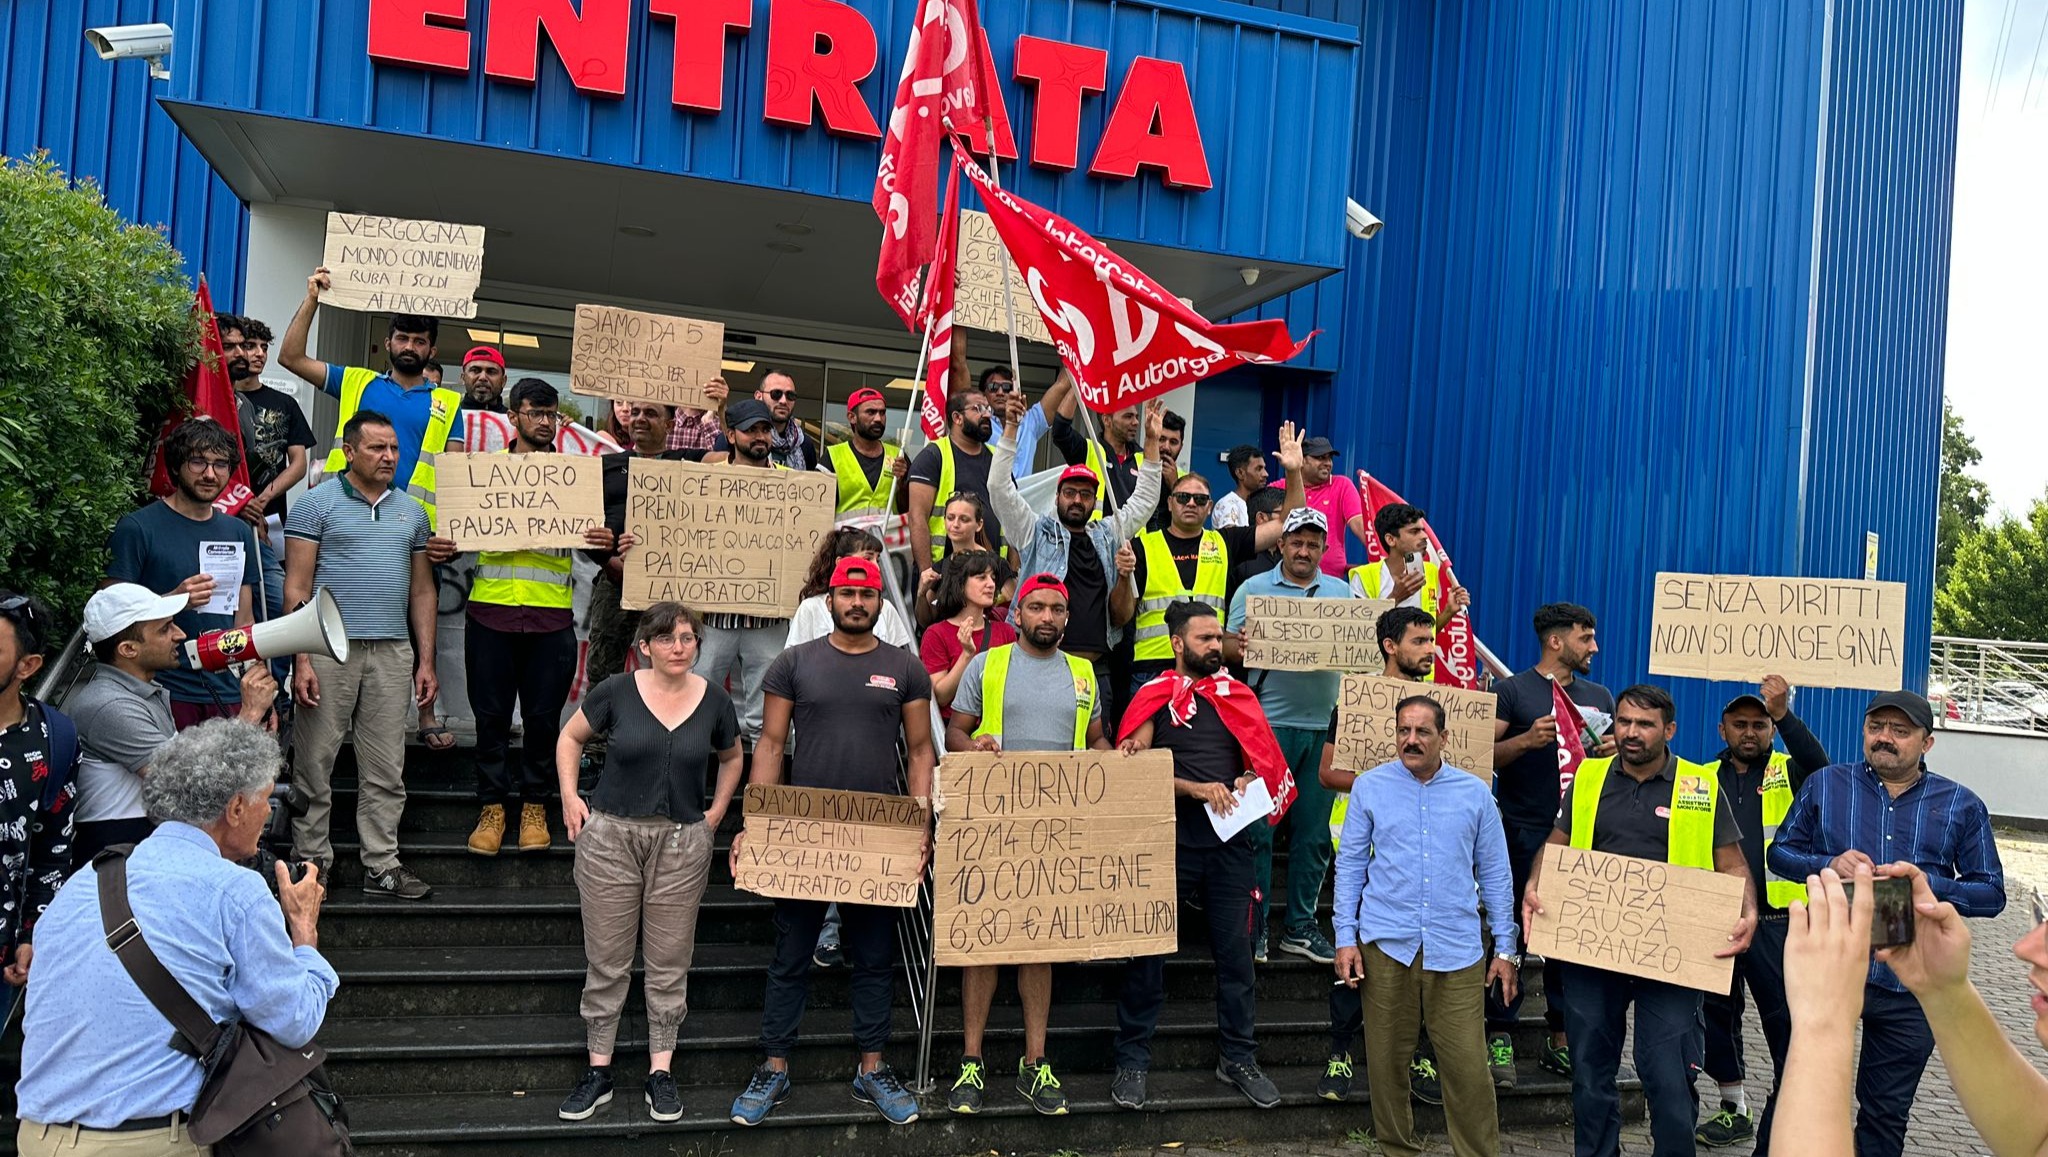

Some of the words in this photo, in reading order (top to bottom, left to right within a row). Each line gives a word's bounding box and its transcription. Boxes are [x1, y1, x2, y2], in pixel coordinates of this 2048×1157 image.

[340, 214, 468, 245] VERGOGNA
[964, 214, 984, 238] 12
[340, 245, 398, 266] MONDO
[402, 249, 480, 272] CONVENIENZA
[966, 242, 980, 260] 6
[350, 270, 390, 285] RUBA
[412, 274, 449, 288] SOLDI
[579, 308, 640, 338] SIAMO
[647, 320, 675, 342] DA
[686, 324, 703, 344] 5
[954, 300, 998, 328] BASTA
[577, 334, 636, 358] GIORNI
[644, 344, 662, 361] IN
[574, 354, 664, 380] SCIOPERO
[668, 366, 686, 384] PER
[696, 370, 699, 386] I
[574, 374, 630, 394] NOSTRI
[644, 381, 701, 404] DIRITTI
[468, 464, 576, 488] LAVORO
[632, 473, 672, 494] NON
[720, 478, 827, 508] PARCHEGGIO?
[479, 491, 560, 510] SENZA
[632, 495, 695, 521] PRENDI
[704, 504, 727, 524] LA
[450, 516, 518, 540] PAUSA
[528, 516, 596, 537] PRANZO
[632, 524, 649, 546] SI
[660, 525, 719, 550] ROMPE
[645, 552, 746, 578] PAGANO
[768, 559, 772, 576] I
[648, 580, 776, 603] LAVORATORI
[1662, 580, 1766, 614] SENZA
[1780, 582, 1881, 620] DIRITTI
[1252, 596, 1278, 617] PIÙ
[1284, 600, 1302, 618] DI
[1314, 602, 1345, 619] 100
[1350, 604, 1373, 618] KG
[1252, 620, 1266, 639] AL
[1272, 620, 1323, 641] SESTO
[1332, 624, 1376, 643] PIANO
[1654, 623, 1708, 654] NON
[1713, 623, 1732, 655] SI
[1742, 623, 1897, 667] CONSEGNA
[1245, 650, 1264, 662] DA
[1272, 647, 1320, 666] PORTARE
[1330, 644, 1338, 664] A
[1345, 646, 1382, 666] MANO
[1344, 678, 1408, 711] BASTA
[1465, 700, 1492, 720] ORE
[1344, 714, 1376, 735] PER
[954, 766, 974, 820] 1
[982, 760, 1106, 816] GIORNO
[748, 786, 810, 818] SIAMO
[822, 794, 925, 826] MONTATORI
[766, 818, 864, 848] FACCHINI
[948, 821, 1020, 862] 12/14
[1030, 818, 1086, 854] ORE
[750, 845, 862, 872] VOGLIAMO
[881, 857, 902, 877] IL
[1556, 848, 1667, 893] LAVORO
[743, 871, 851, 896] CONTRATTO
[860, 878, 917, 902] GIUSTO
[950, 864, 986, 905] 10
[994, 853, 1153, 901] CONSEGNE
[1564, 878, 1666, 914] SENZA
[950, 908, 1012, 954] 6,80
[1020, 906, 1042, 940] €
[1049, 902, 1129, 940] ALL'ORA
[1132, 900, 1176, 934] LORDI
[1558, 900, 1669, 944] PAUSA
[1554, 926, 1682, 974] PRANZO
